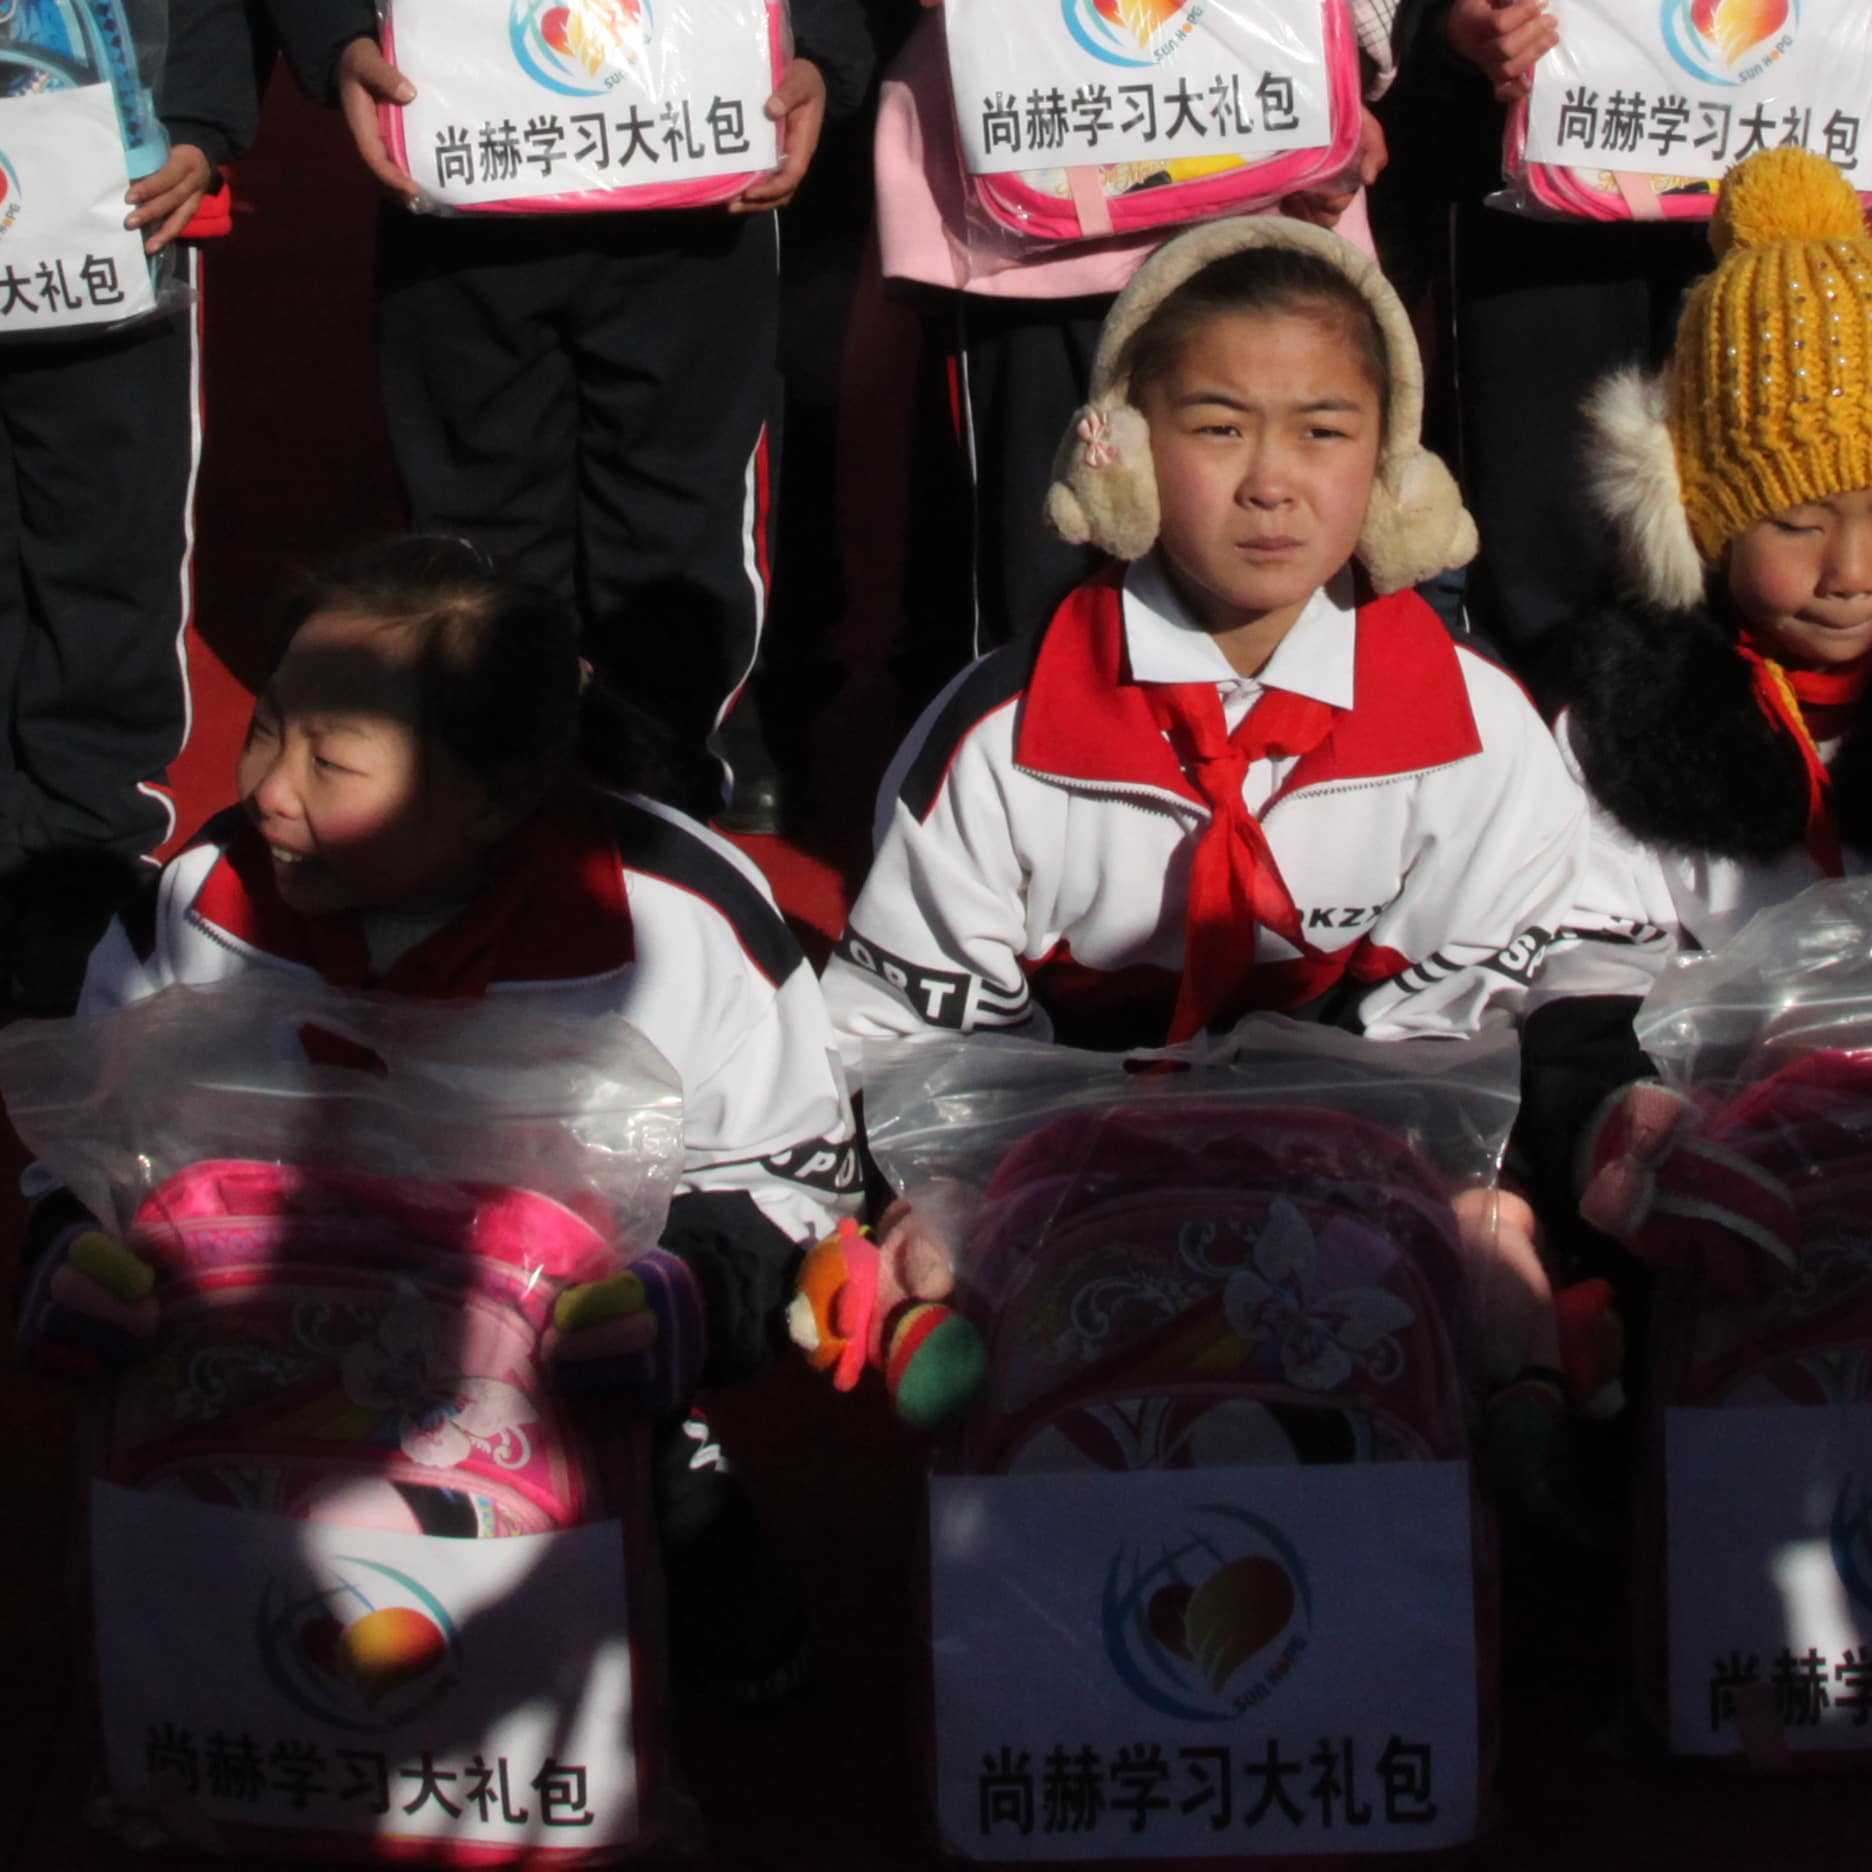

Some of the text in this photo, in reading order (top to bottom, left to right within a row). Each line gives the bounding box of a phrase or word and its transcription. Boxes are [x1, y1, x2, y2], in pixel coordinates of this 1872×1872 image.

[435, 95, 751, 188] 尚赫学习大礼包
[982, 69, 1301, 155] 尚赫学习大礼包
[1556, 85, 1861, 171] 尚赫学习大礼包
[144, 1723, 595, 1828] 尚赫学习大礼包
[978, 1736, 1437, 1835] 尚赫学习大礼包
